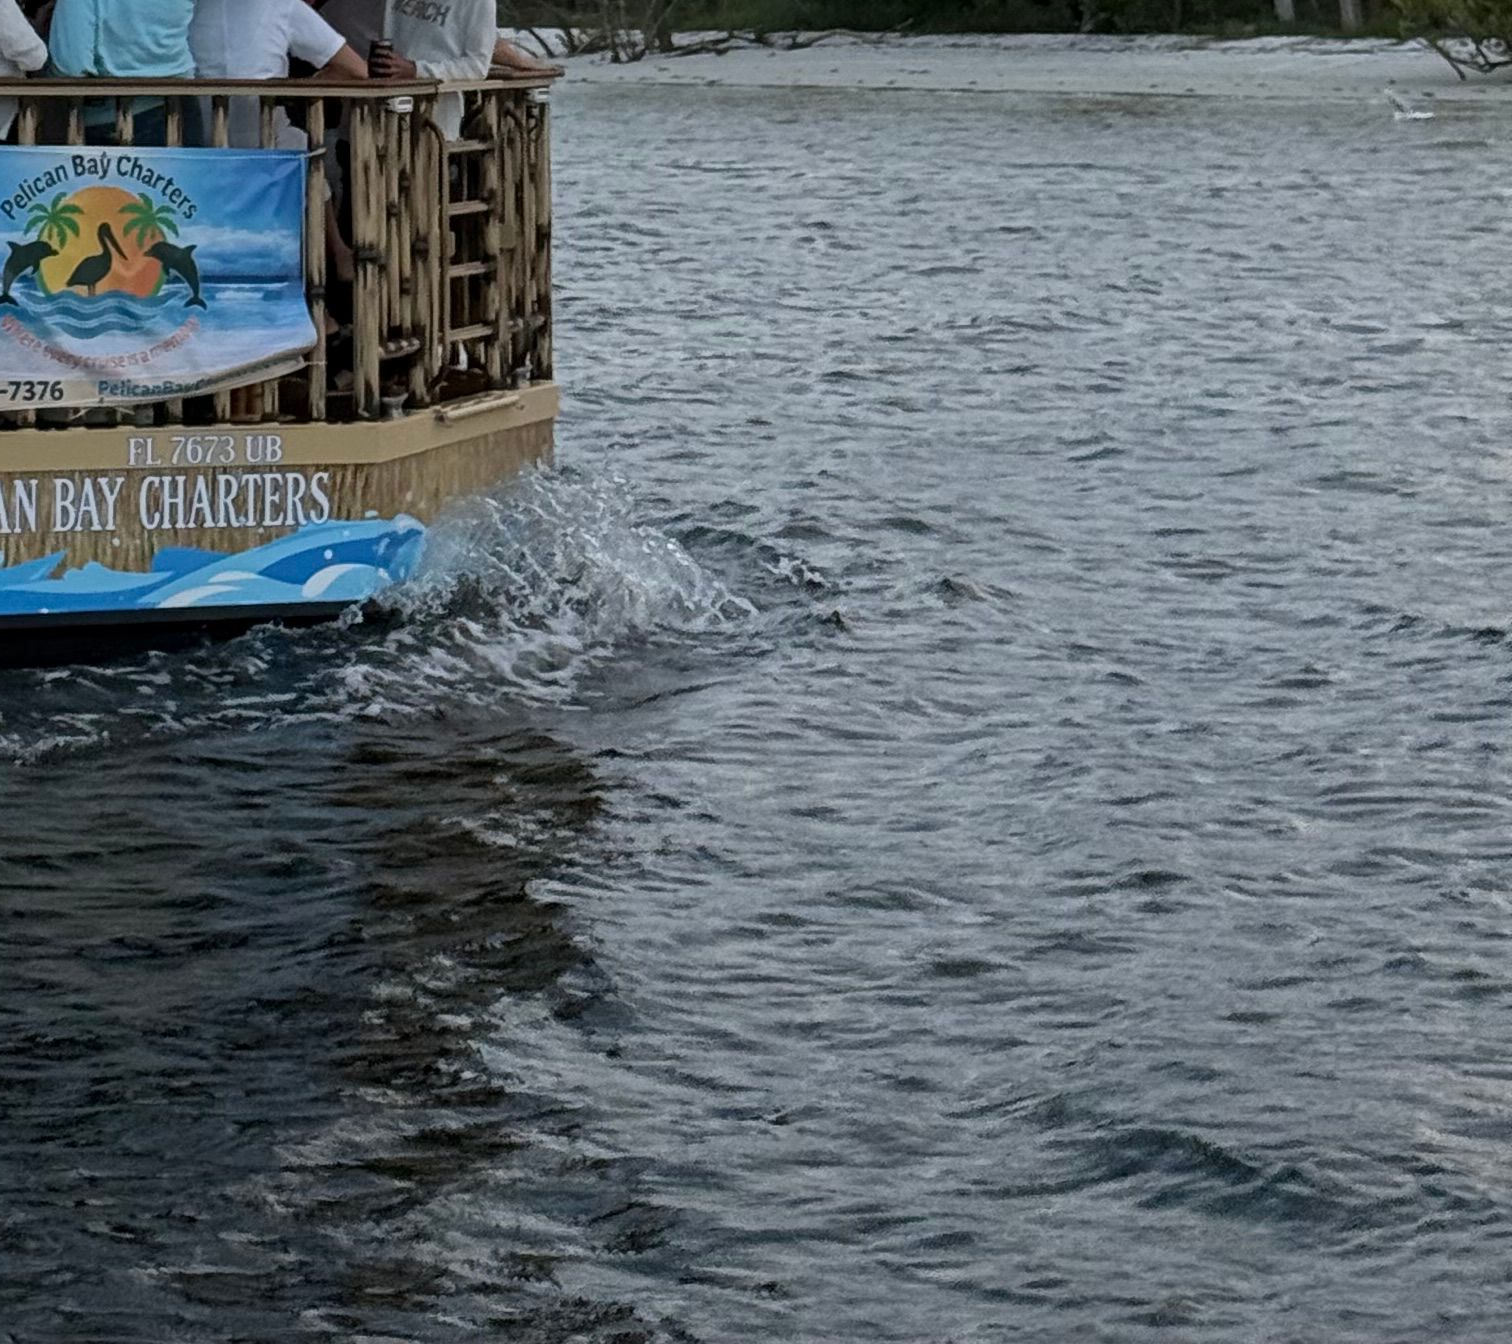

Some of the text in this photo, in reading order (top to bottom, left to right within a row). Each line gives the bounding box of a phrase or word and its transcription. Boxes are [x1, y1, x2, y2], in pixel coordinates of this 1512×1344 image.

[0, 153, 198, 220] Pelican Bay Charters
[127, 434, 283, 467] FL 7673 UB
[52, 475, 124, 534] BAY
[139, 470, 332, 531] CHARTERS
